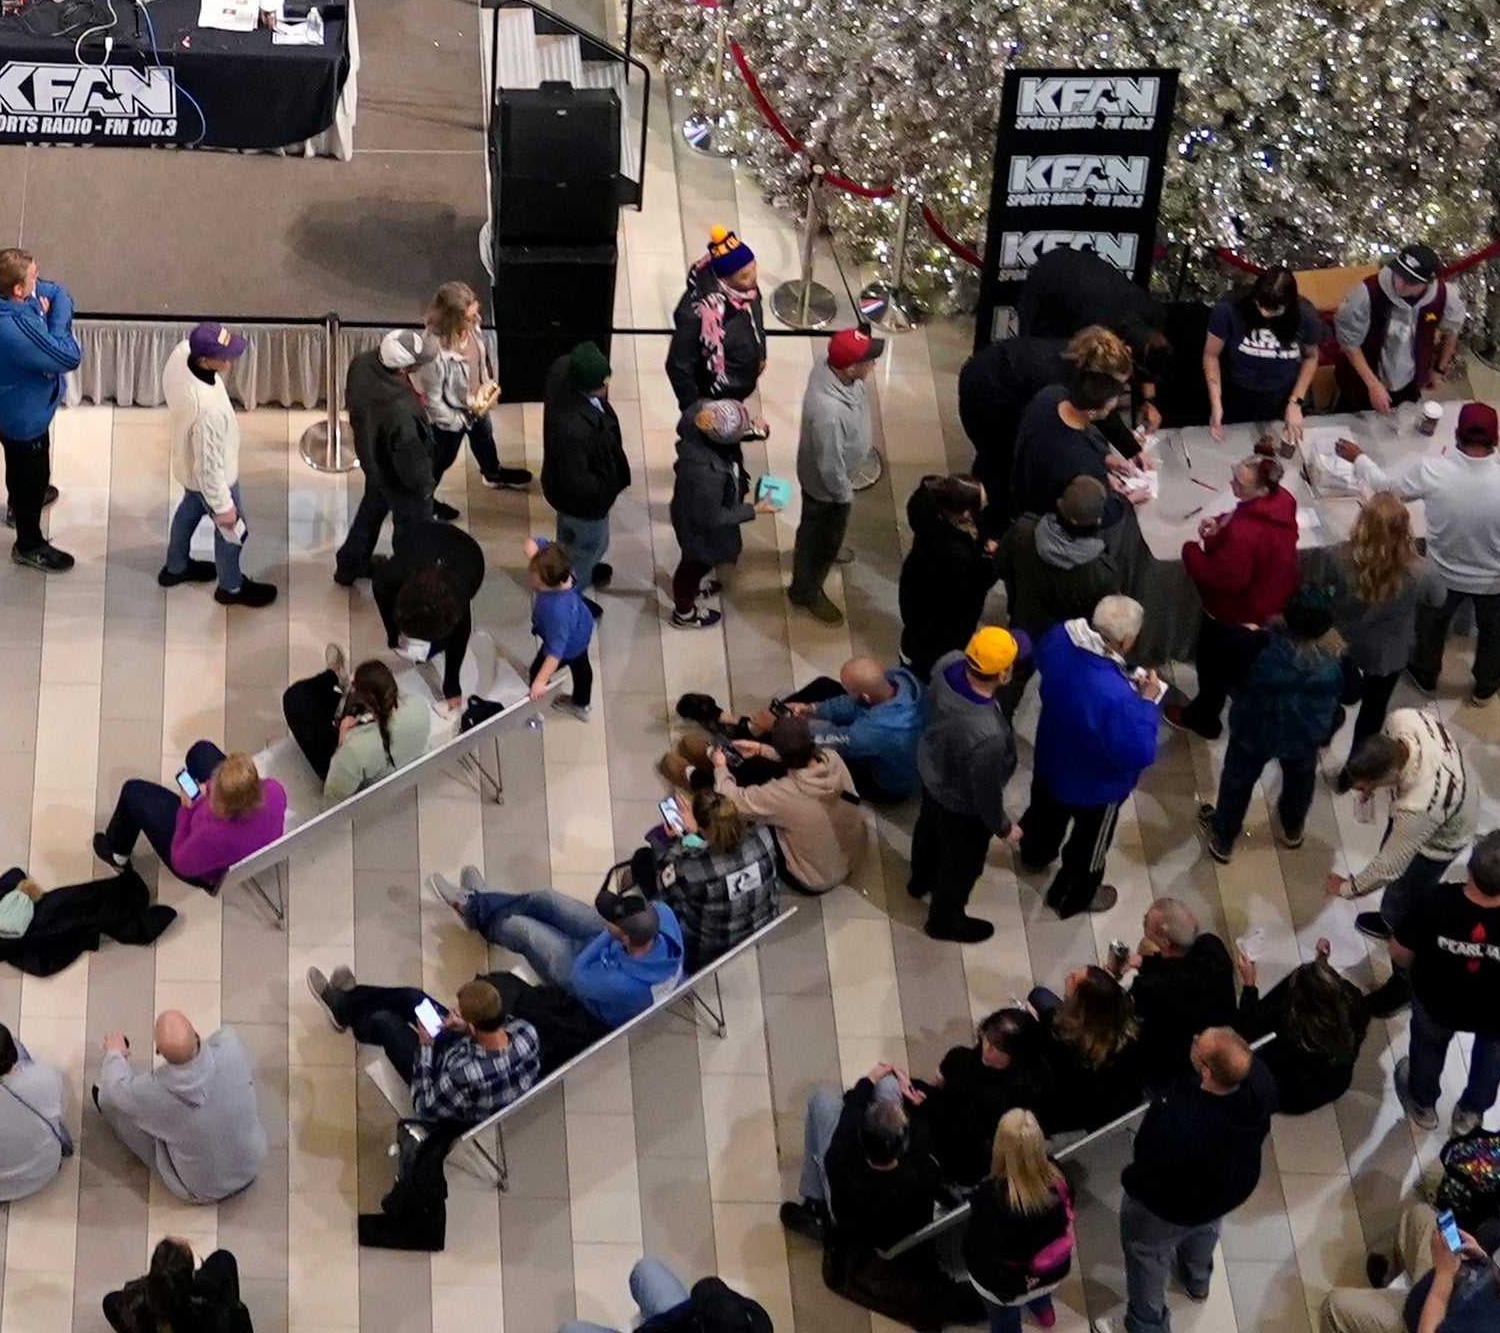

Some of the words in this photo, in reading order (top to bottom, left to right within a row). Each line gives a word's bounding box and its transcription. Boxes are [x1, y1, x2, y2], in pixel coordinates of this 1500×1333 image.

[1015, 76, 1161, 117] KFAN
[41, 116, 92, 135] RADIO
[104, 117, 129, 136] FM
[132, 118, 178, 137] 100.3
[1014, 116, 1060, 131] SPORTS
[1060, 116, 1097, 129] RADIO
[1103, 116, 1121, 129] FM
[1122, 117, 1155, 131] 100.3
[1007, 154, 1150, 195] KFAN
[1006, 193, 1050, 208] SPORTS
[1050, 193, 1087, 206] RADIO
[1093, 193, 1111, 206] FM
[1112, 193, 1144, 208] 100.3
[1437, 935, 1484, 958] PEARL
